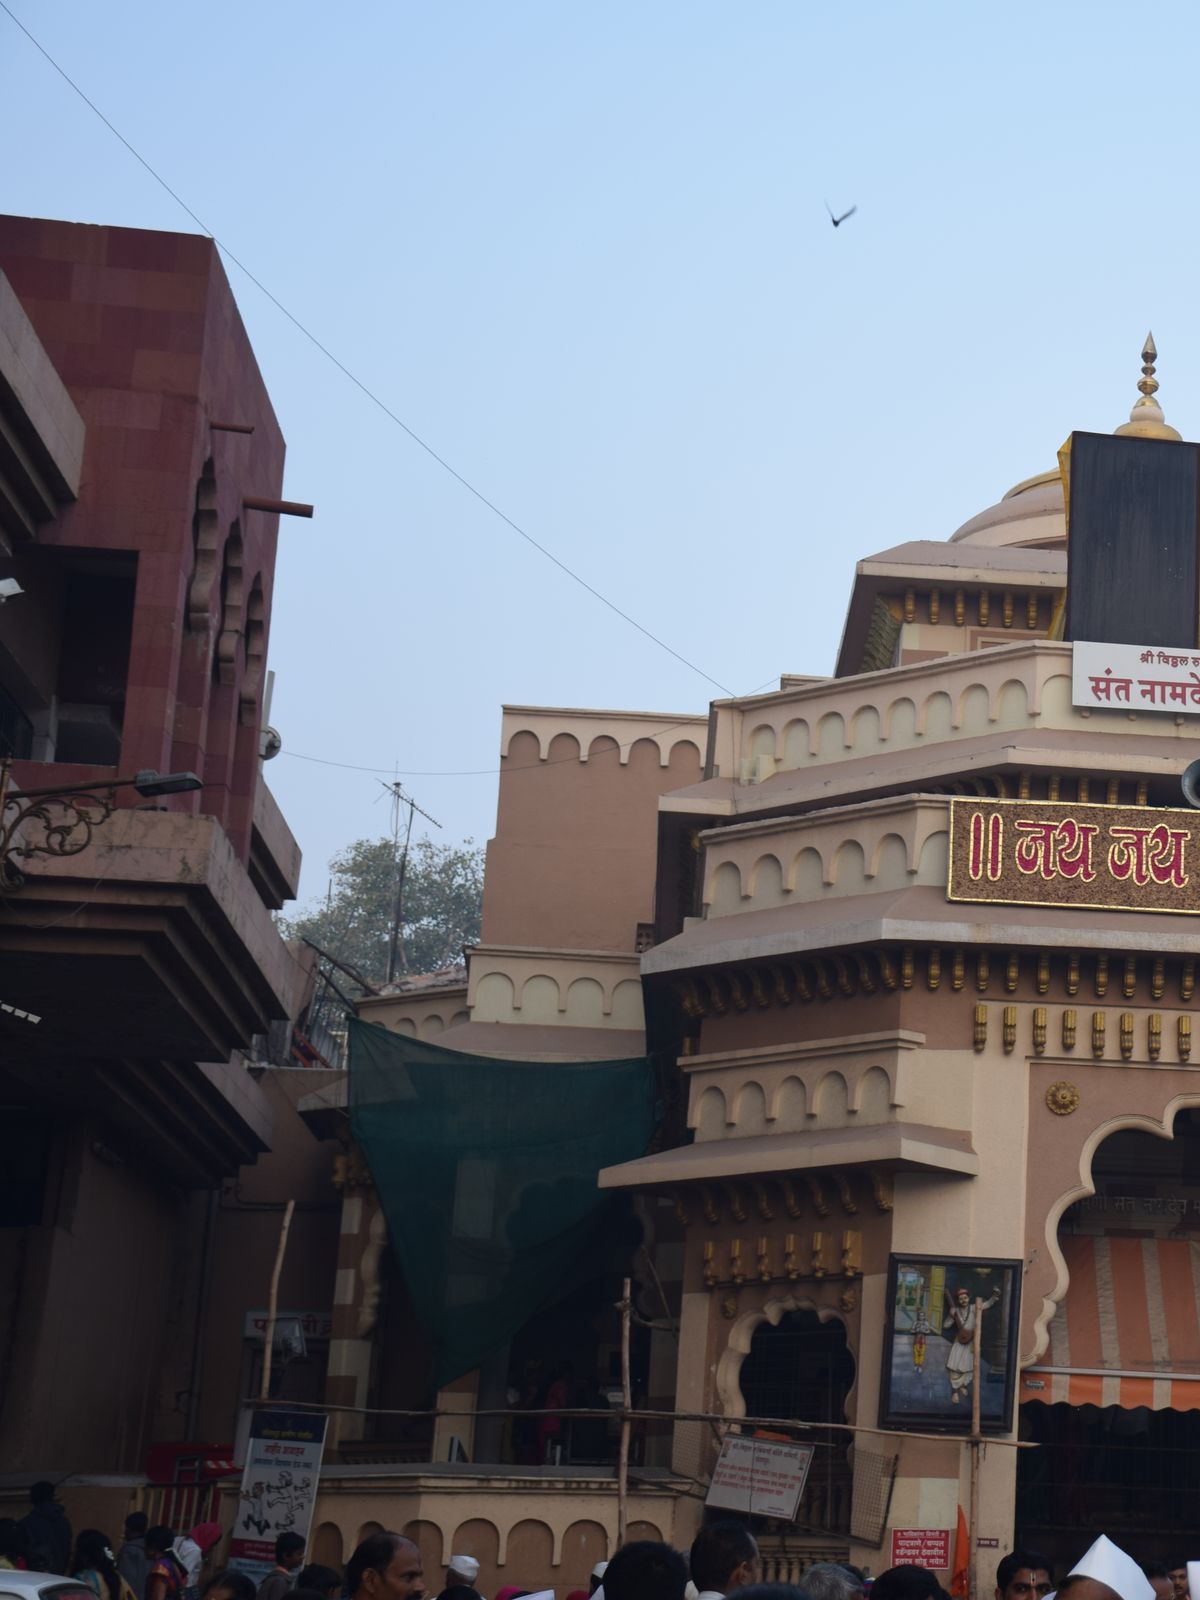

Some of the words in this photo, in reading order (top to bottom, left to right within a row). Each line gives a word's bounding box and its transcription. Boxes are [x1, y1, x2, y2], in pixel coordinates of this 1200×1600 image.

[1140, 651, 1154, 666] श्री
[1157, 652, 1189, 668] विठ्ठल
[1088, 667, 1133, 702] संत
[1015, 818, 1099, 883] जय
[1108, 823, 1191, 888] जय
